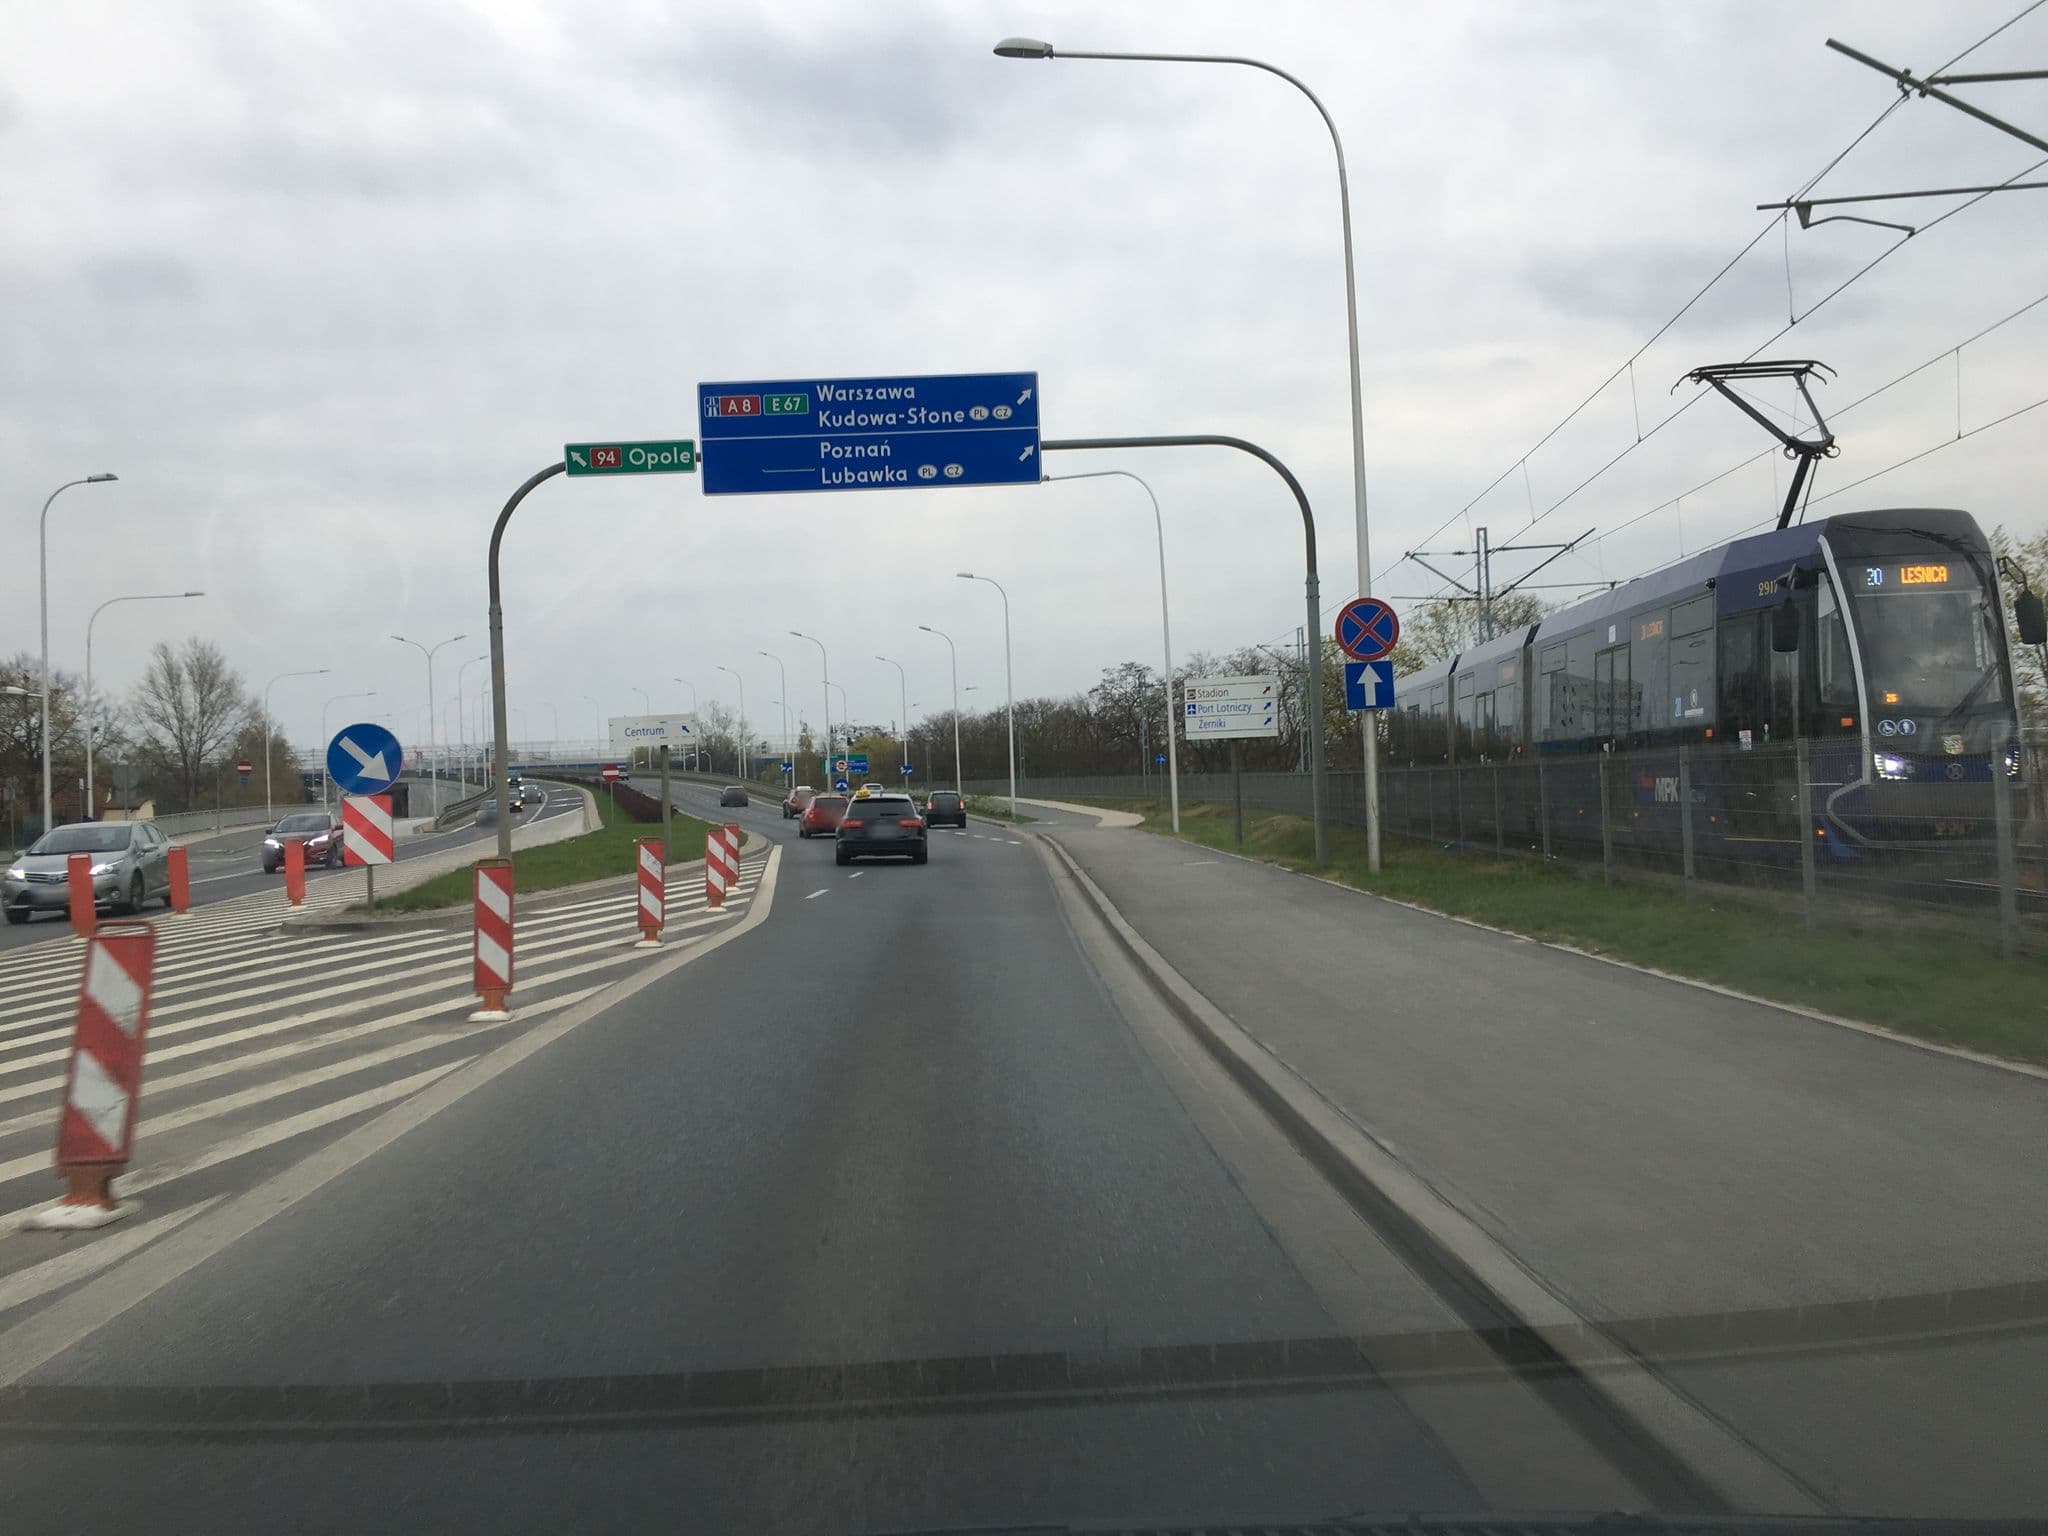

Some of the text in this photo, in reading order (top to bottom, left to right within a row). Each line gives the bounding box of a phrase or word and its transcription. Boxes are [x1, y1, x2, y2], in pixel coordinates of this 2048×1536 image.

[816, 384, 915, 402] Warszawa
[727, 398, 751, 414] A 8
[772, 397, 801, 412] E 67
[818, 407, 1008, 428] Kudowa-Słone PL CZ
[597, 447, 691, 470] 94 Opole
[820, 440, 891, 459] Poznań
[821, 465, 908, 484] Lubawka
[946, 466, 960, 476] CZ
[1866, 563, 1947, 586] 20 LEŚNICA
[1197, 688, 1229, 699] Stadion
[1198, 703, 1252, 715] Port Lotniczy
[624, 727, 665, 737] Centrum
